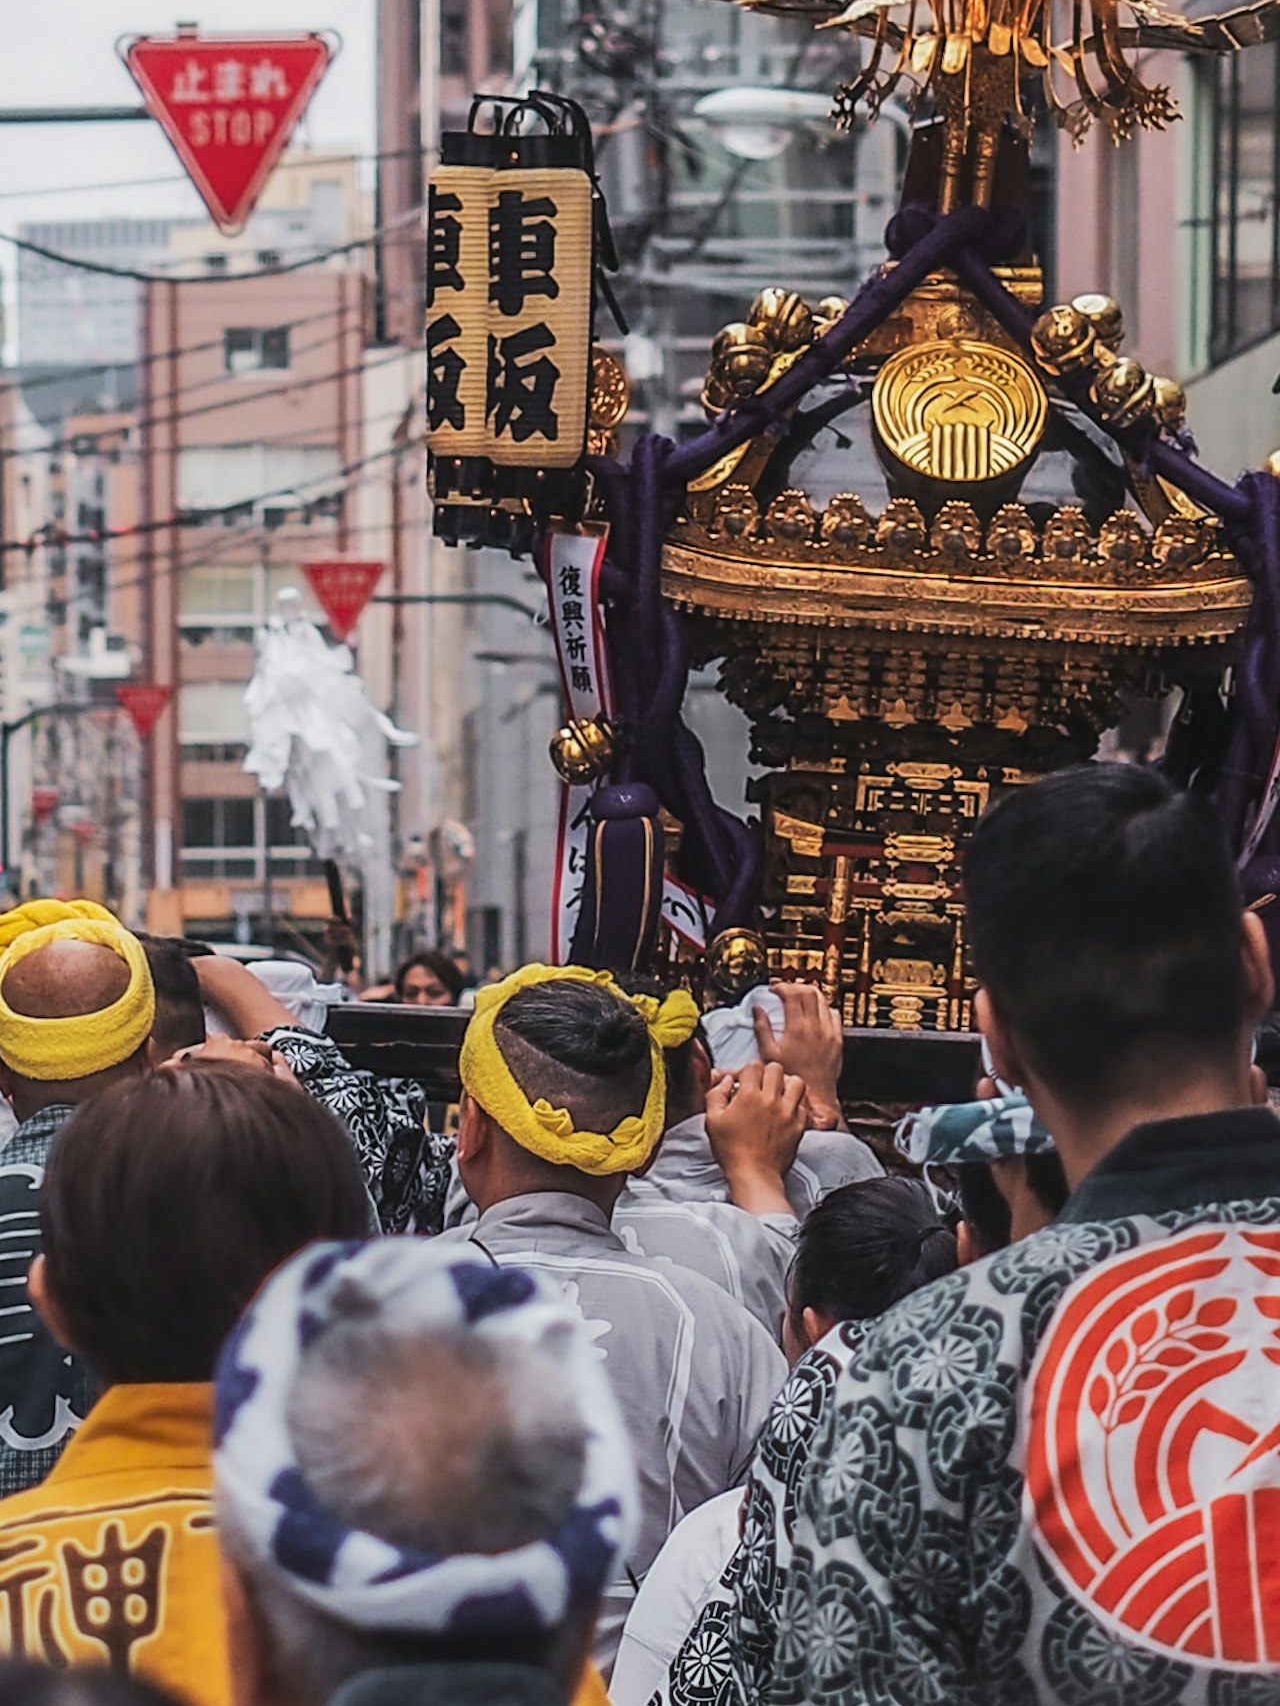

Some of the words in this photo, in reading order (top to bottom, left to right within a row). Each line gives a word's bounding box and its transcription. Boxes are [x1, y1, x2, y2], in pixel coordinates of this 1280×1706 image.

[173, 59, 288, 103] 止まれ
[188, 109, 274, 147] STOP
[558, 564, 594, 695] 復興祈願
